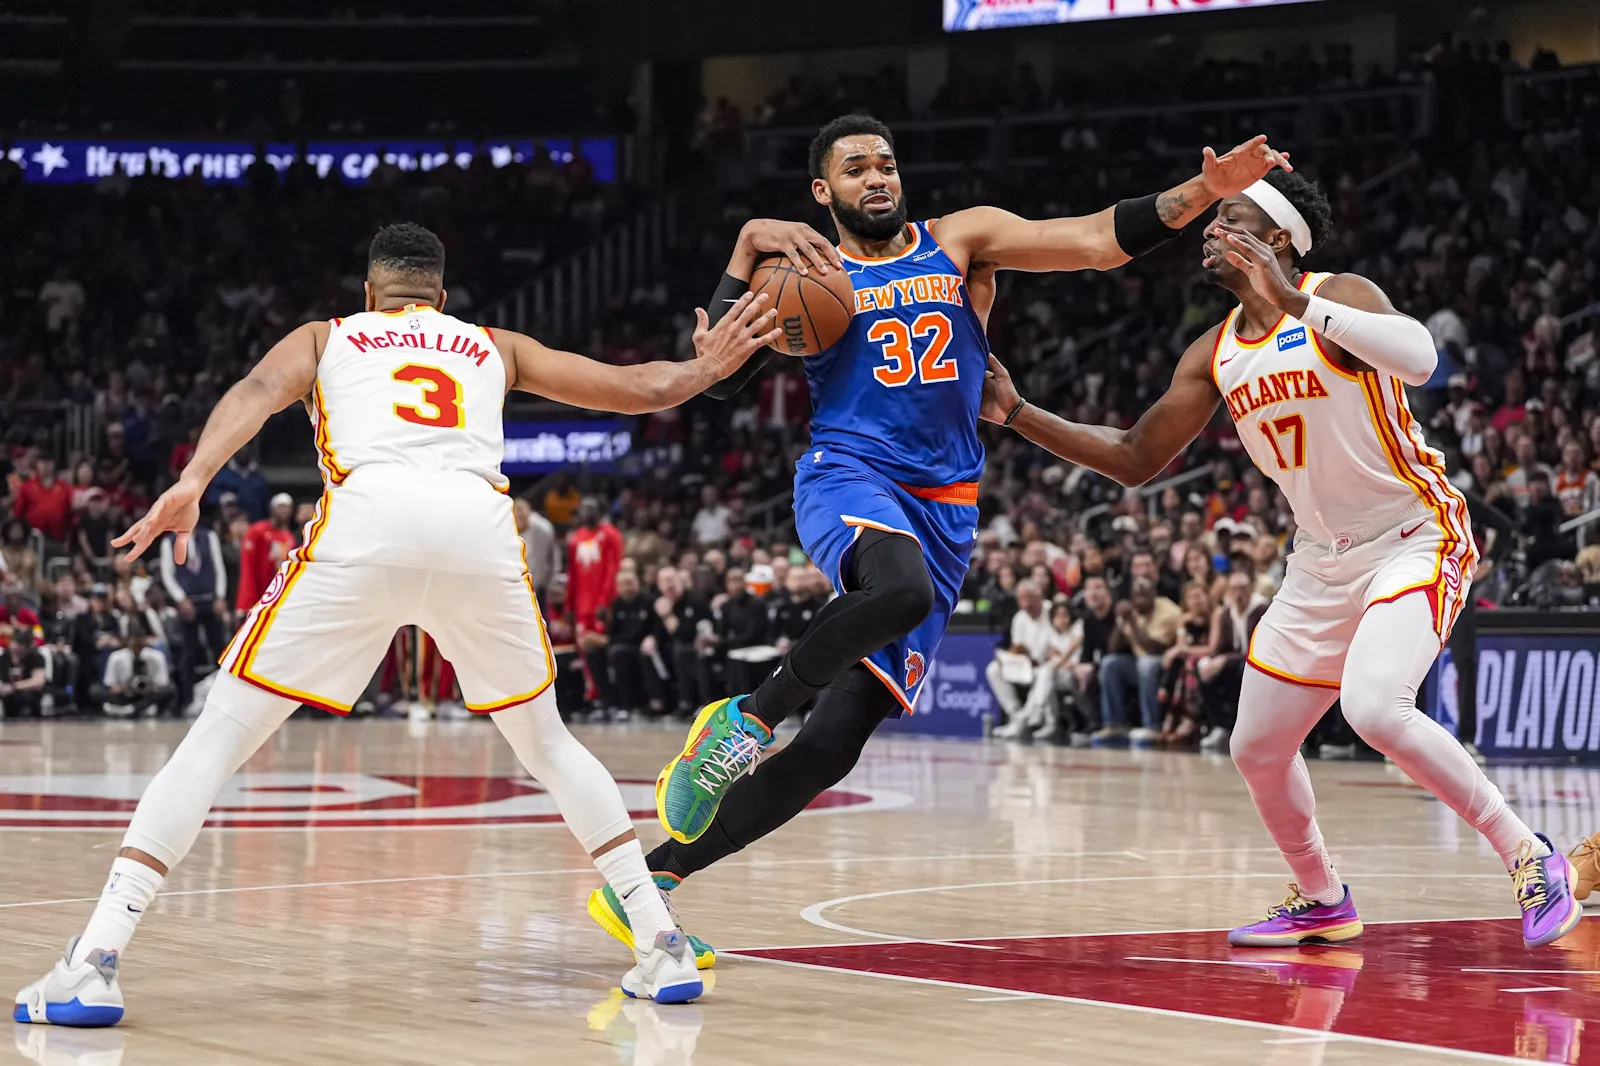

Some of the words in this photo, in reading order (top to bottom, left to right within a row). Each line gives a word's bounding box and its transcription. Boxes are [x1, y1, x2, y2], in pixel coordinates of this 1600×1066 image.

[854, 281, 895, 315] EW
[895, 274, 963, 307] YORK
[347, 331, 490, 367] McCOLLUM
[867, 311, 959, 388] 32
[1279, 331, 1304, 347] paze
[391, 362, 465, 429] 3
[1226, 369, 1330, 423] ATLANTA
[1258, 413, 1306, 470] 17
